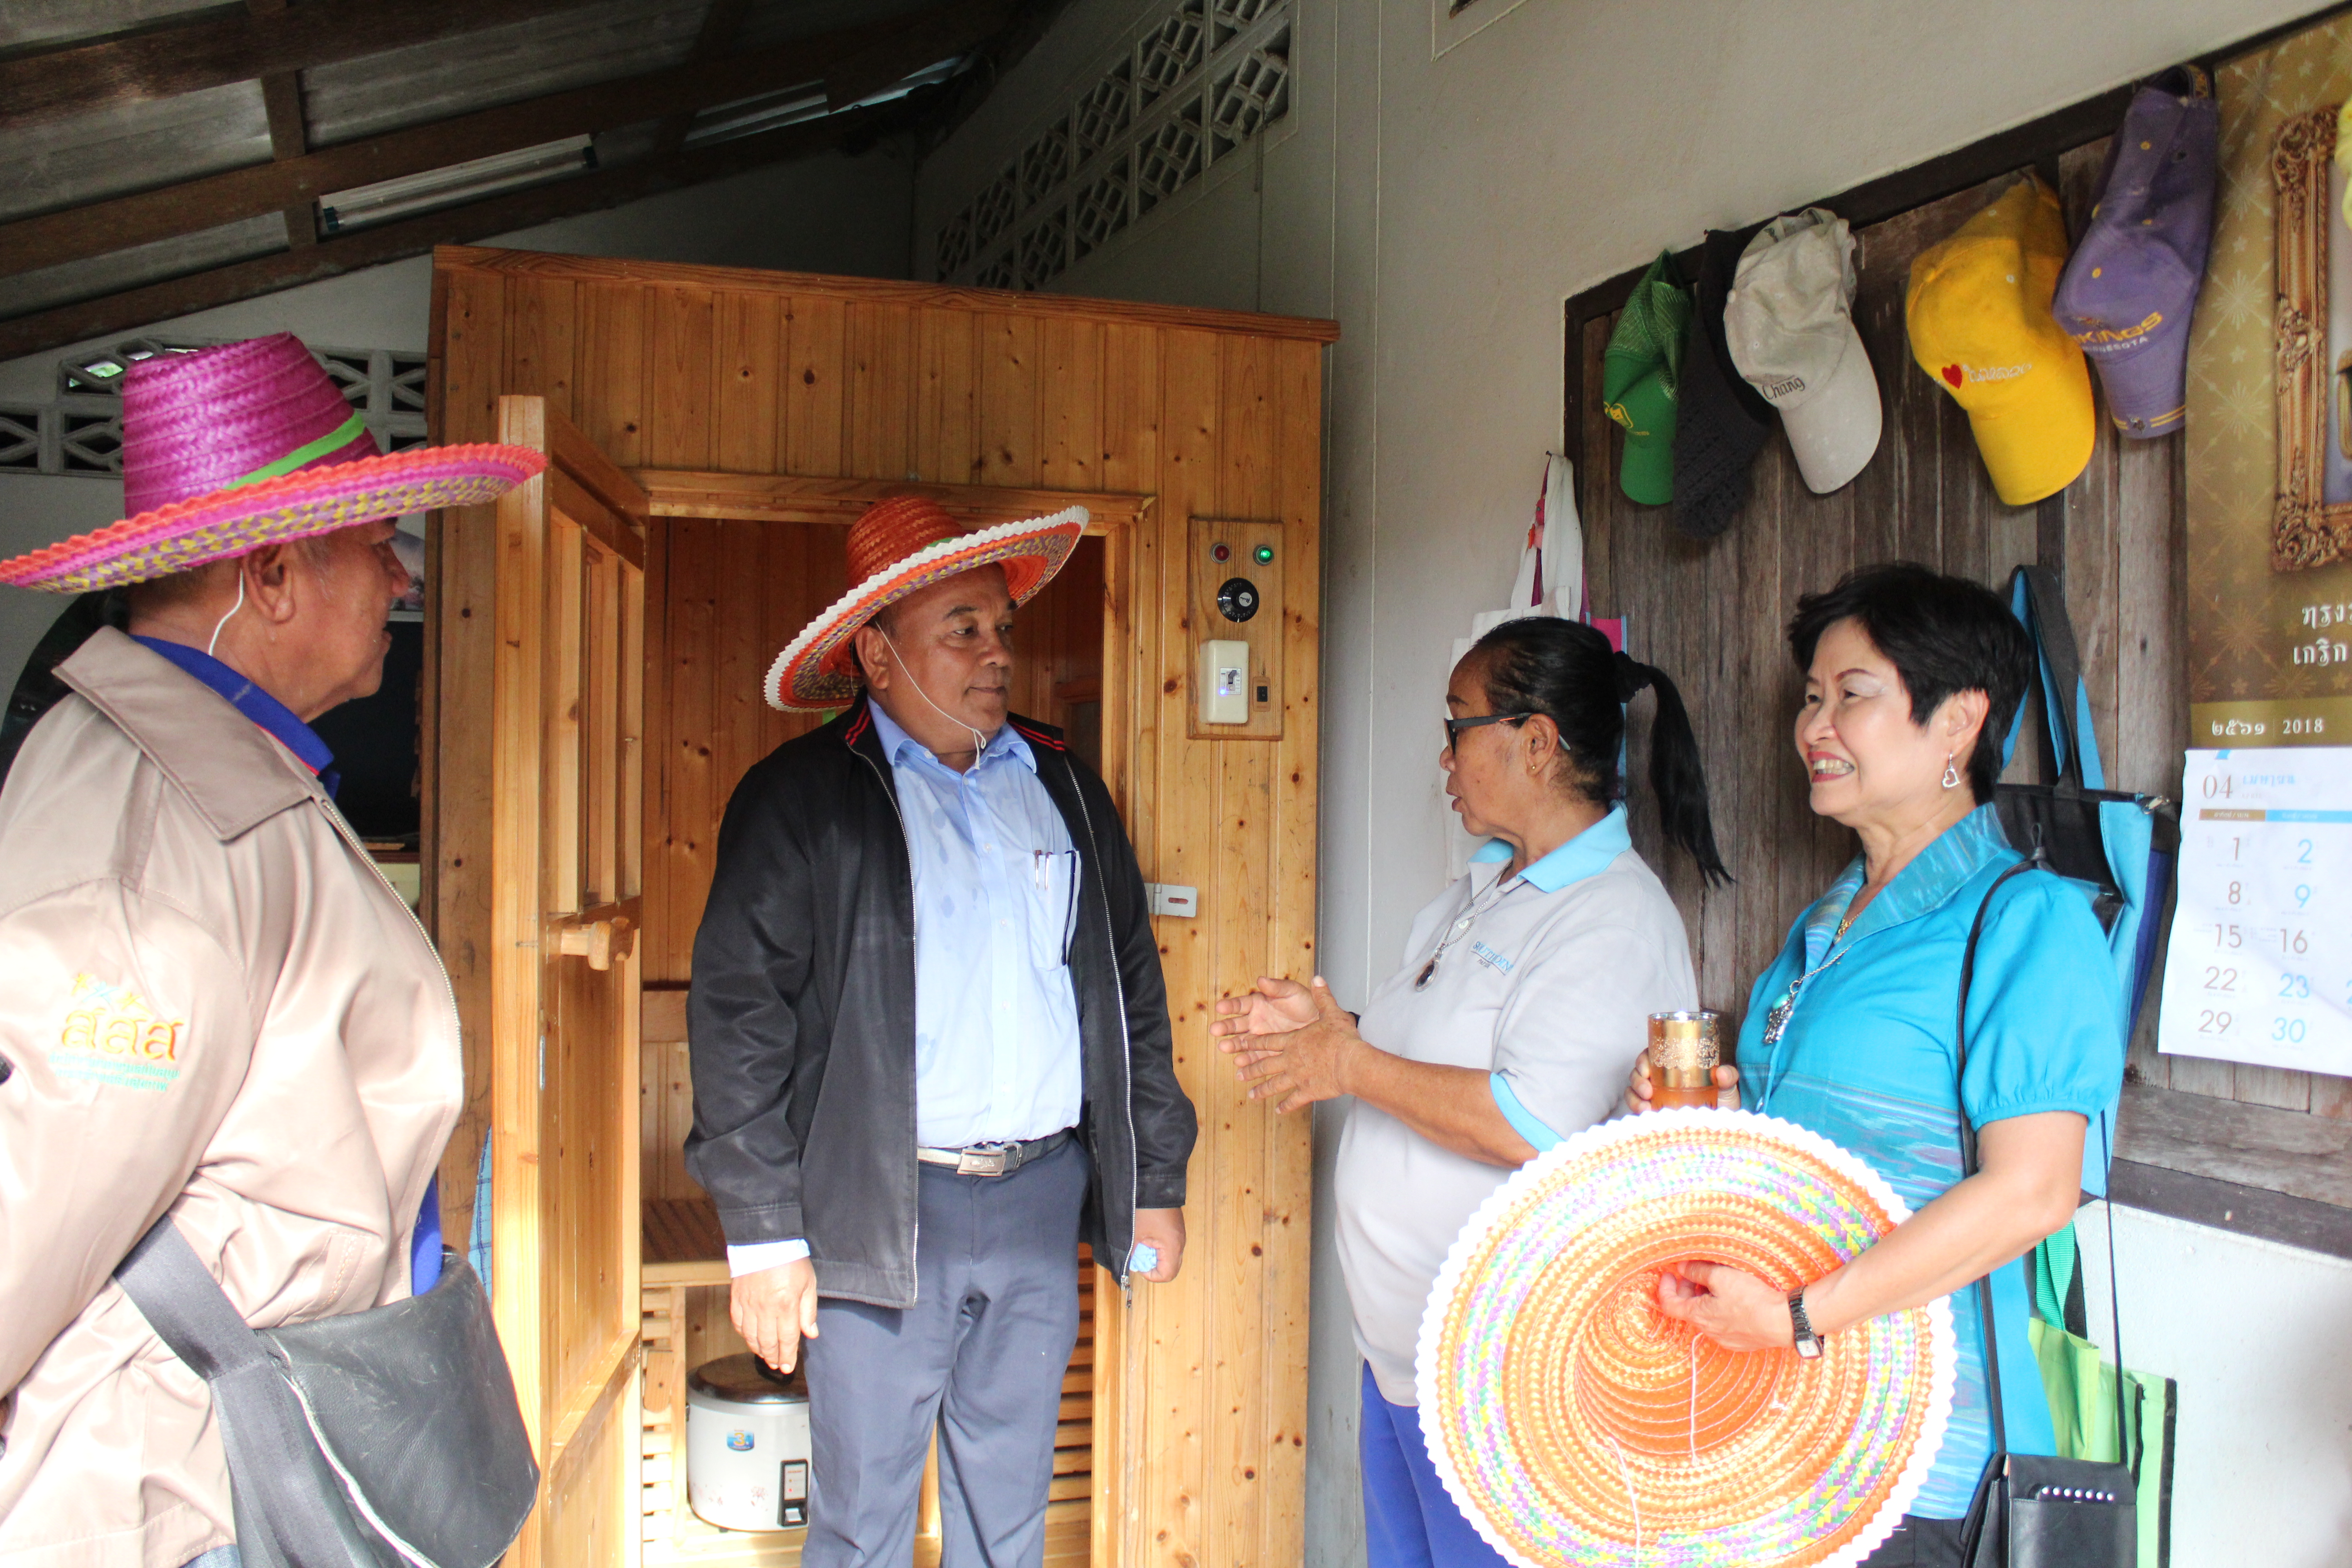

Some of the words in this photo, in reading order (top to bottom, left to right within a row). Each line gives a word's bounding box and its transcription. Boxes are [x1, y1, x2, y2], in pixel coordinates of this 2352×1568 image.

[1762, 375, 1806, 400] Chang
[2211, 719, 2266, 736] ๒๕๖๑
[2283, 718, 2324, 735] 2018
[2202, 774, 2233, 799] 04
[2232, 837, 2240, 861] 1
[2297, 838, 2313, 863] 2
[2228, 881, 2241, 905] 8
[2294, 884, 2311, 908] 9
[2215, 923, 2242, 948] 15
[2279, 928, 2308, 954] 16
[2203, 966, 2237, 991] 22
[2278, 973, 2310, 999] 23
[2198, 1009, 2232, 1034] 29
[2271, 1017, 2306, 1043] 30
[733, 1432, 746, 1447] 3
